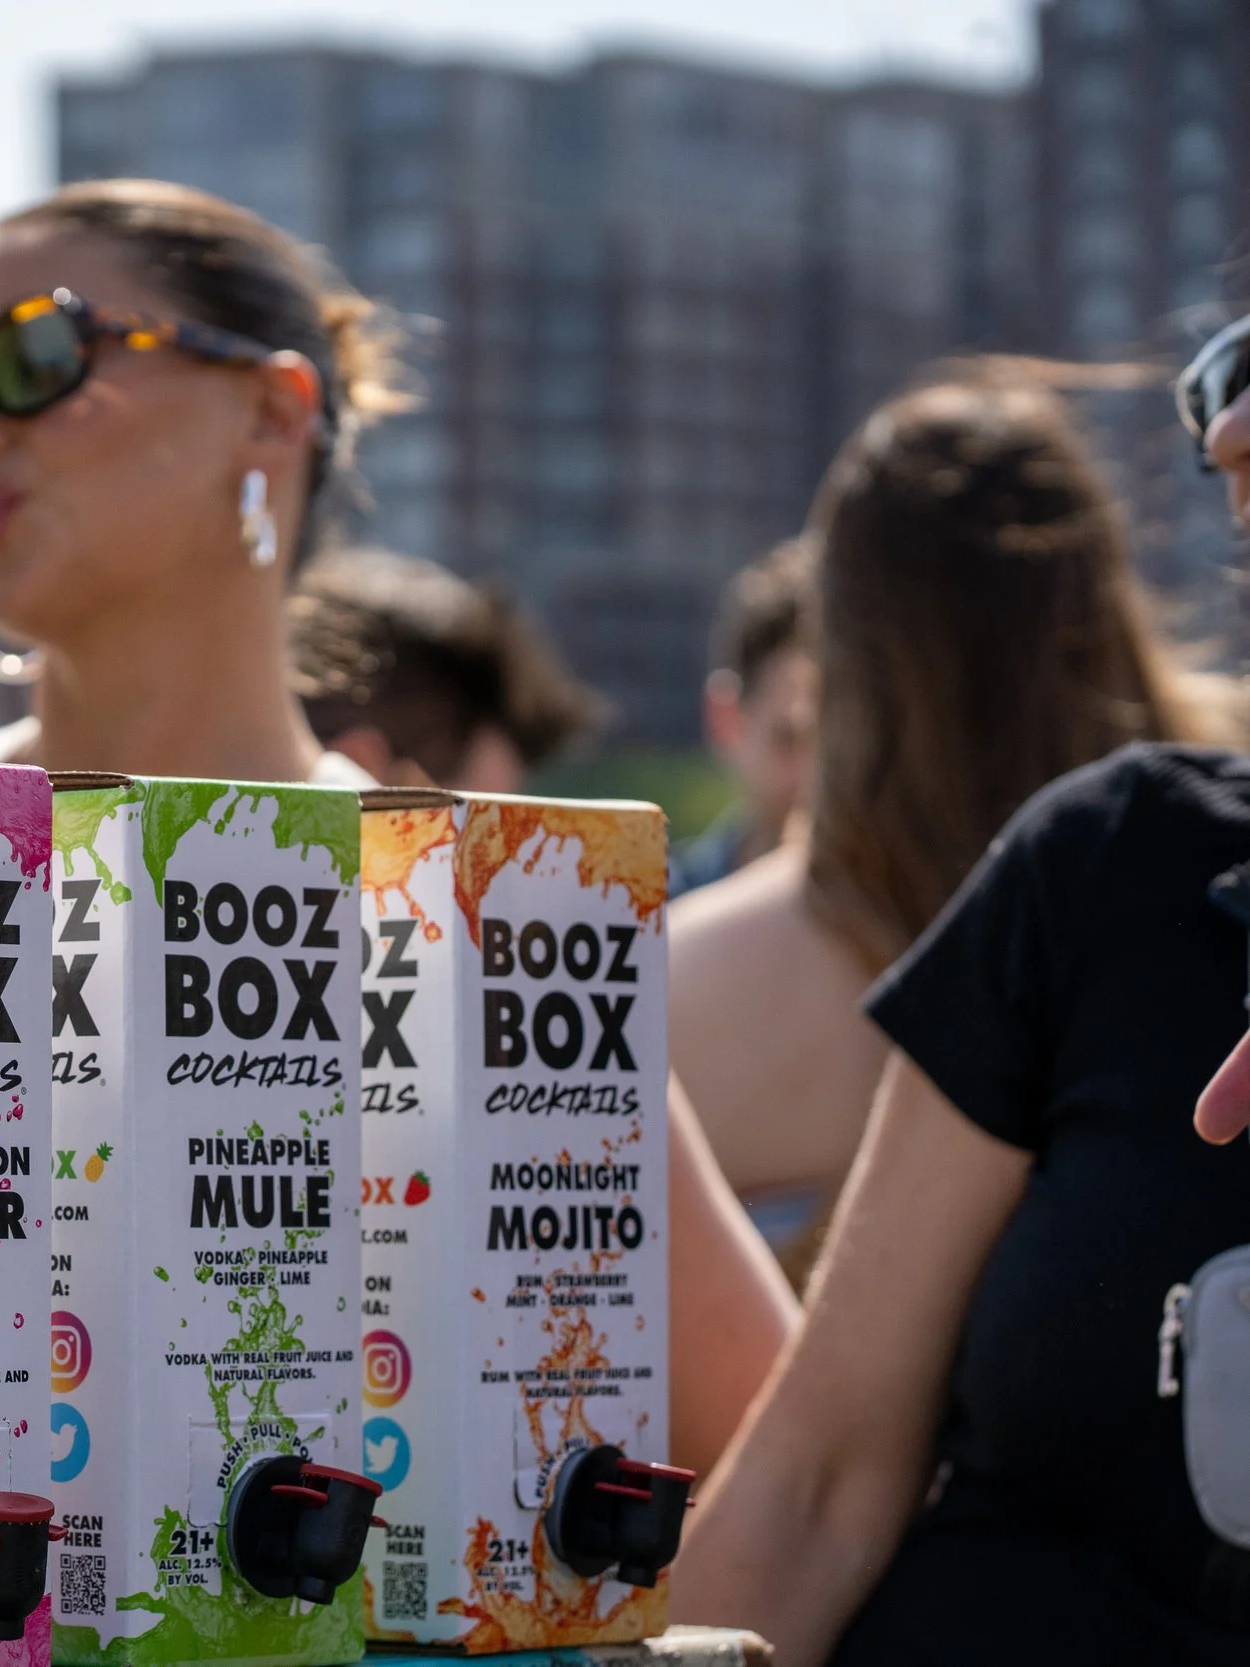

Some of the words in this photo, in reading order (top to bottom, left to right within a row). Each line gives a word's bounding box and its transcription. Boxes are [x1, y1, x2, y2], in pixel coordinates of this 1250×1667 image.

[52, 879, 101, 942] Z
[164, 880, 340, 948] BOOZ
[482, 919, 638, 982] BOOZ
[165, 954, 340, 1041] BOX
[483, 989, 638, 1072] BOX
[167, 1050, 342, 1088] COCKTAILS
[485, 1081, 640, 1116] COCKTAILS
[189, 1138, 330, 1166] PINEAPPLE
[490, 1163, 640, 1191] MOONLIGHT
[190, 1175, 331, 1228] MULE
[487, 1205, 643, 1251] MOJITO
[194, 1251, 243, 1264] VODKA
[258, 1251, 328, 1264] PINEAPPLE
[214, 1271, 266, 1286] GINGER
[280, 1271, 310, 1285] LIME
[365, 1276, 391, 1292] ON
[165, 1353, 207, 1365] VODKA
[211, 1352, 239, 1364] WITH
[244, 1352, 269, 1364] REAL
[274, 1351, 302, 1363] FRUIT
[306, 1351, 332, 1362] JUICE
[335, 1350, 354, 1361] AND
[5, 1370, 29, 1383] AND
[214, 1369, 263, 1381] NATURAL
[268, 1368, 316, 1379] FLAVORS.
[217, 1441, 243, 1489] PUSH
[250, 1423, 281, 1440] PULL
[62, 1515, 103, 1530] SCAN
[64, 1532, 101, 1547] HERE
[170, 1530, 214, 1555] 21+
[489, 1539, 529, 1562] 21+
[159, 1559, 181, 1570] ALC.
[187, 1557, 222, 1569] 12.5%
[168, 1574, 181, 1585] BY
[185, 1573, 208, 1584] VOL.
